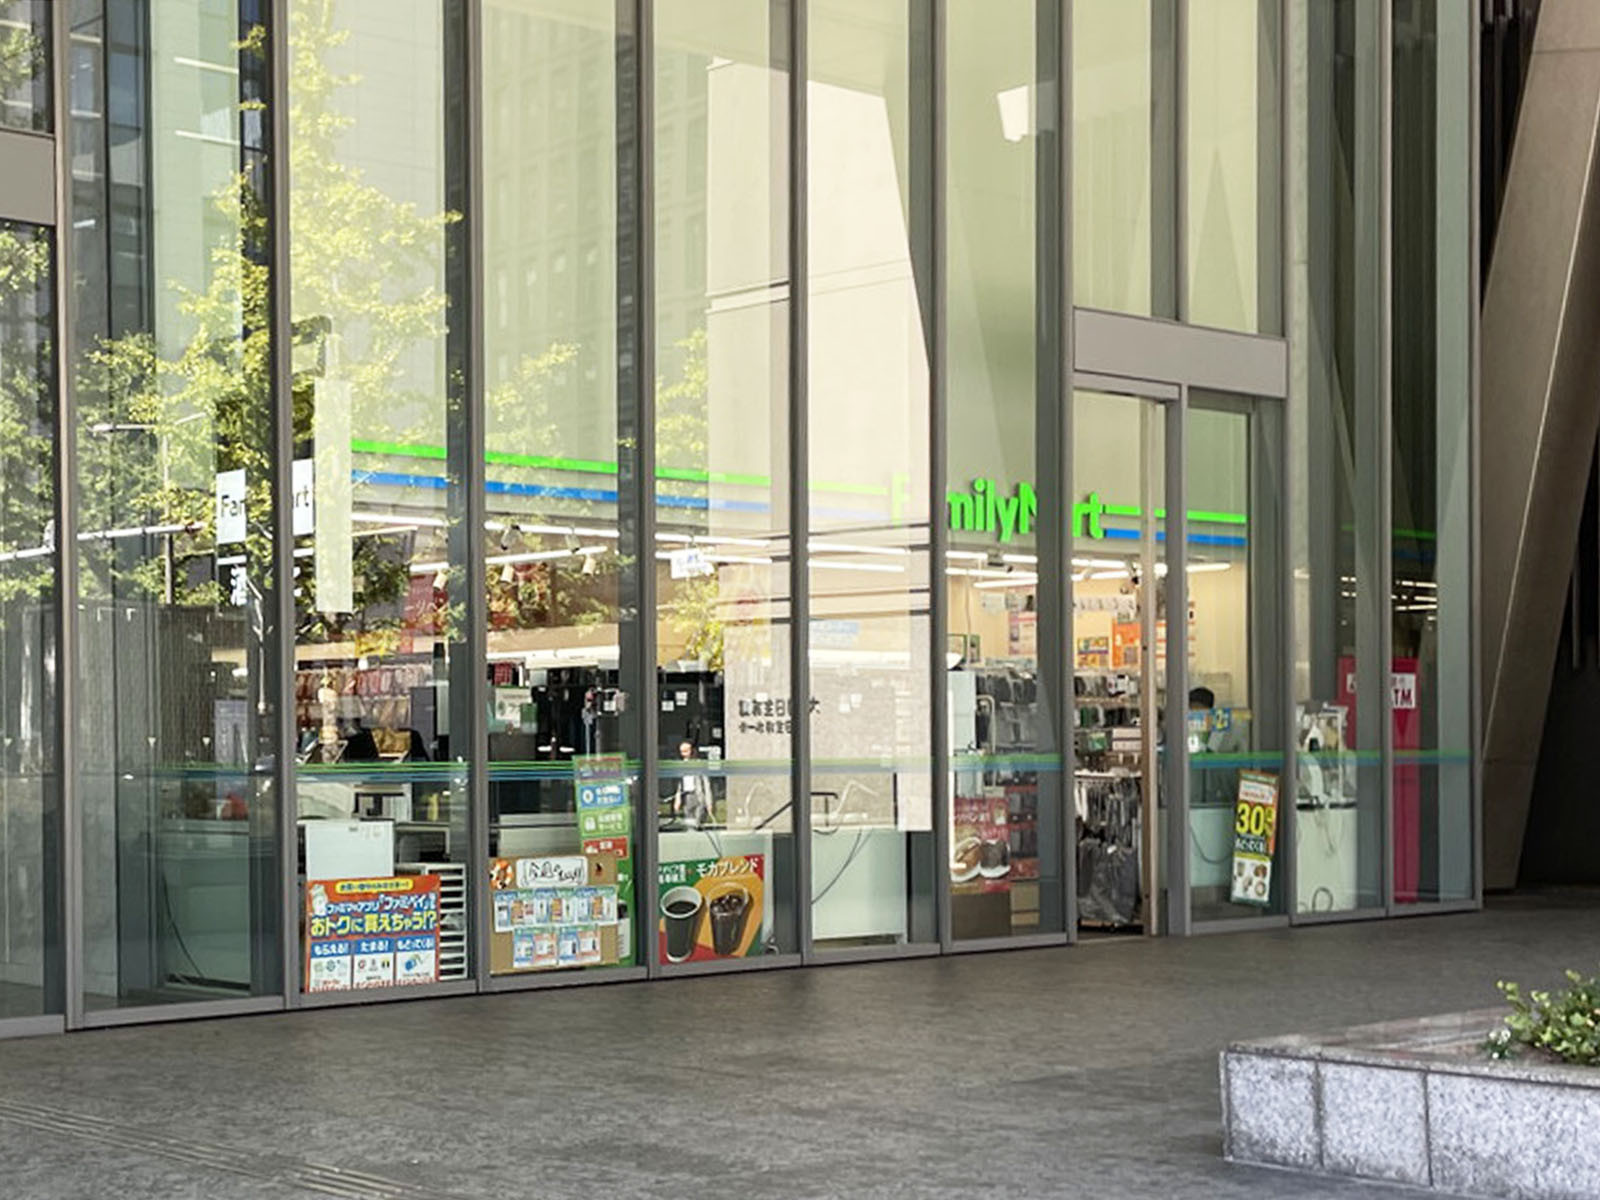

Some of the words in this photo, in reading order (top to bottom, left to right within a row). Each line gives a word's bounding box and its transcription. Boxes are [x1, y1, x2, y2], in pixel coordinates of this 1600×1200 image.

[695, 857, 759, 878] モカブレンド
